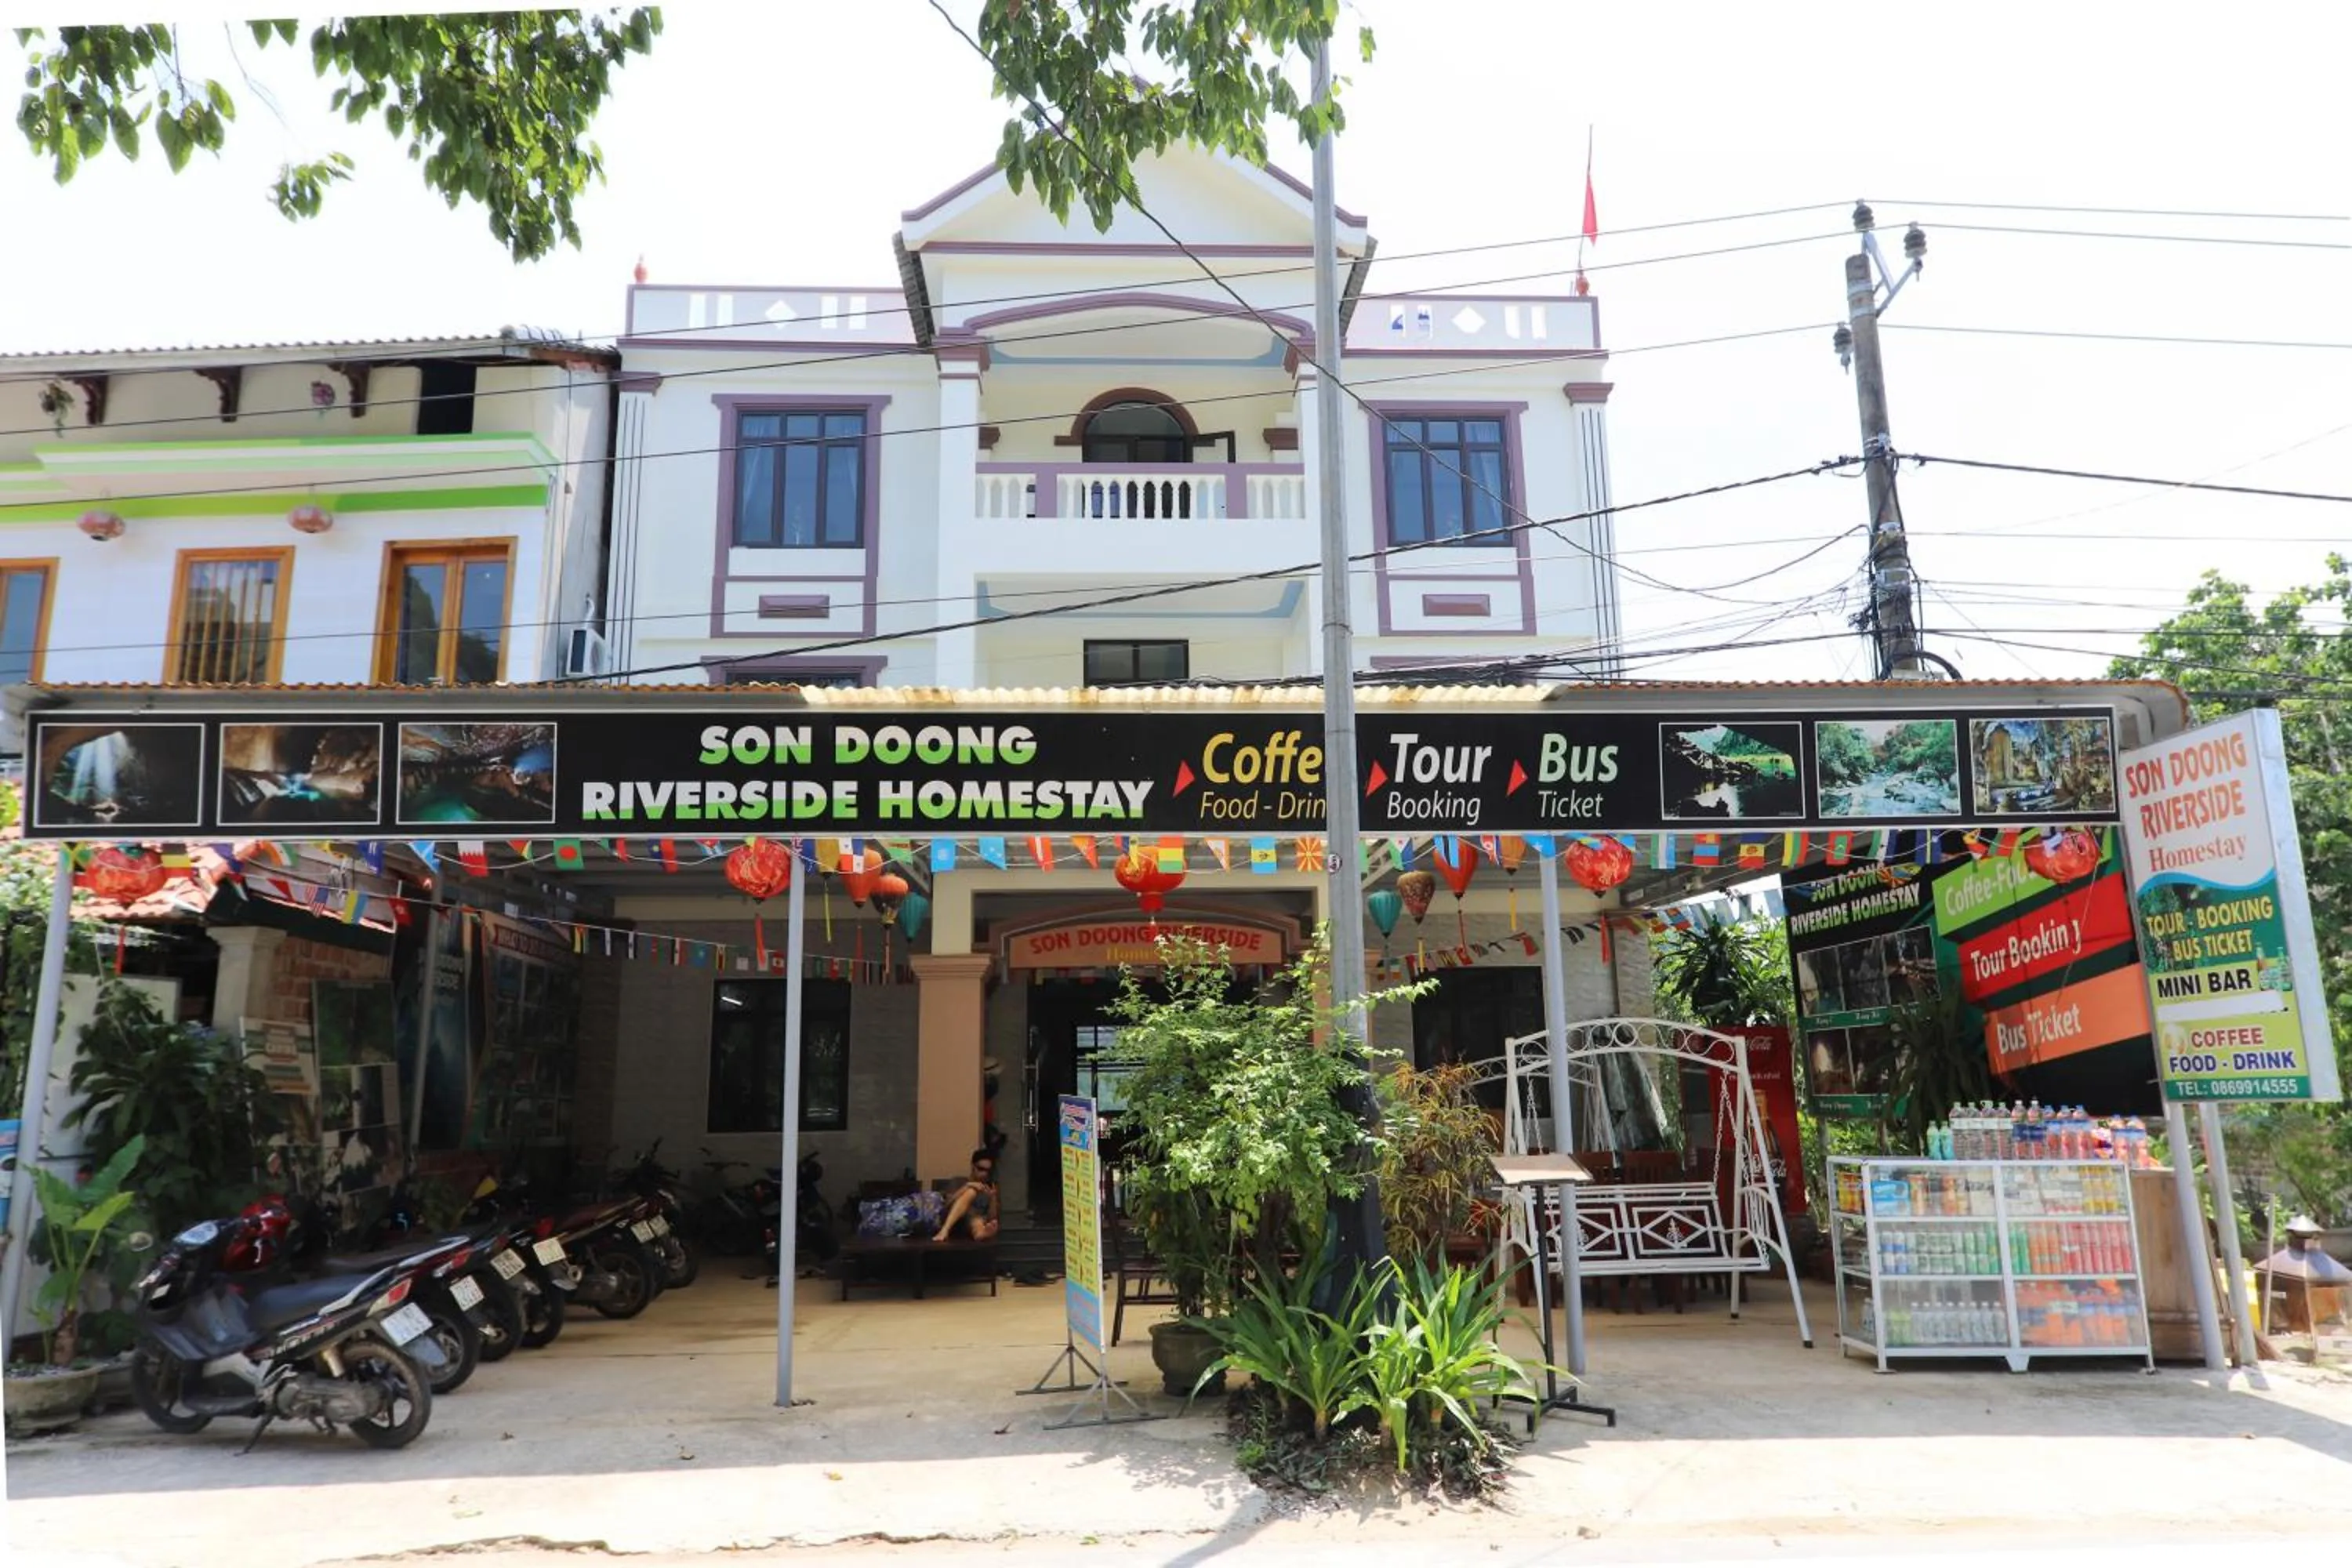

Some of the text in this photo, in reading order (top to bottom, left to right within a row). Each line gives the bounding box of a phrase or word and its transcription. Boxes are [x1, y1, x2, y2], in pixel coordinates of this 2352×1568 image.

[699, 725, 1038, 764] SON DOONG
[1202, 731, 1323, 783] Coffe
[1388, 732, 1492, 783] Tour
[1538, 732, 1618, 783] Bus
[2125, 732, 2247, 798] SON DOONG
[582, 779, 1155, 820] RIVERSIDE HOMESTAY
[1200, 790, 1256, 819] Food
[1278, 791, 1327, 819] Drin
[1387, 790, 1481, 825] Booking
[1538, 791, 1603, 818] Ticket
[2140, 779, 2245, 840] RIVERSIDE
[2148, 835, 2246, 872] Homestay
[1791, 882, 1920, 936] RIVERSIDE HOMESTAY
[2146, 912, 2185, 938] TOUR
[2197, 895, 2273, 929] BOOKING
[1030, 931, 1070, 955] SON
[2172, 929, 2252, 961] BUS TICKET
[1970, 948, 2006, 982] Tour
[2157, 968, 2252, 998] MINI BAR
[1998, 1004, 2082, 1054] Bus Ticket
[2191, 1027, 2264, 1048] COFFEE
[2169, 1055, 2216, 1073] FOOD
[2233, 1051, 2296, 1070] DRINK
[2176, 1082, 2208, 1095] TEL:
